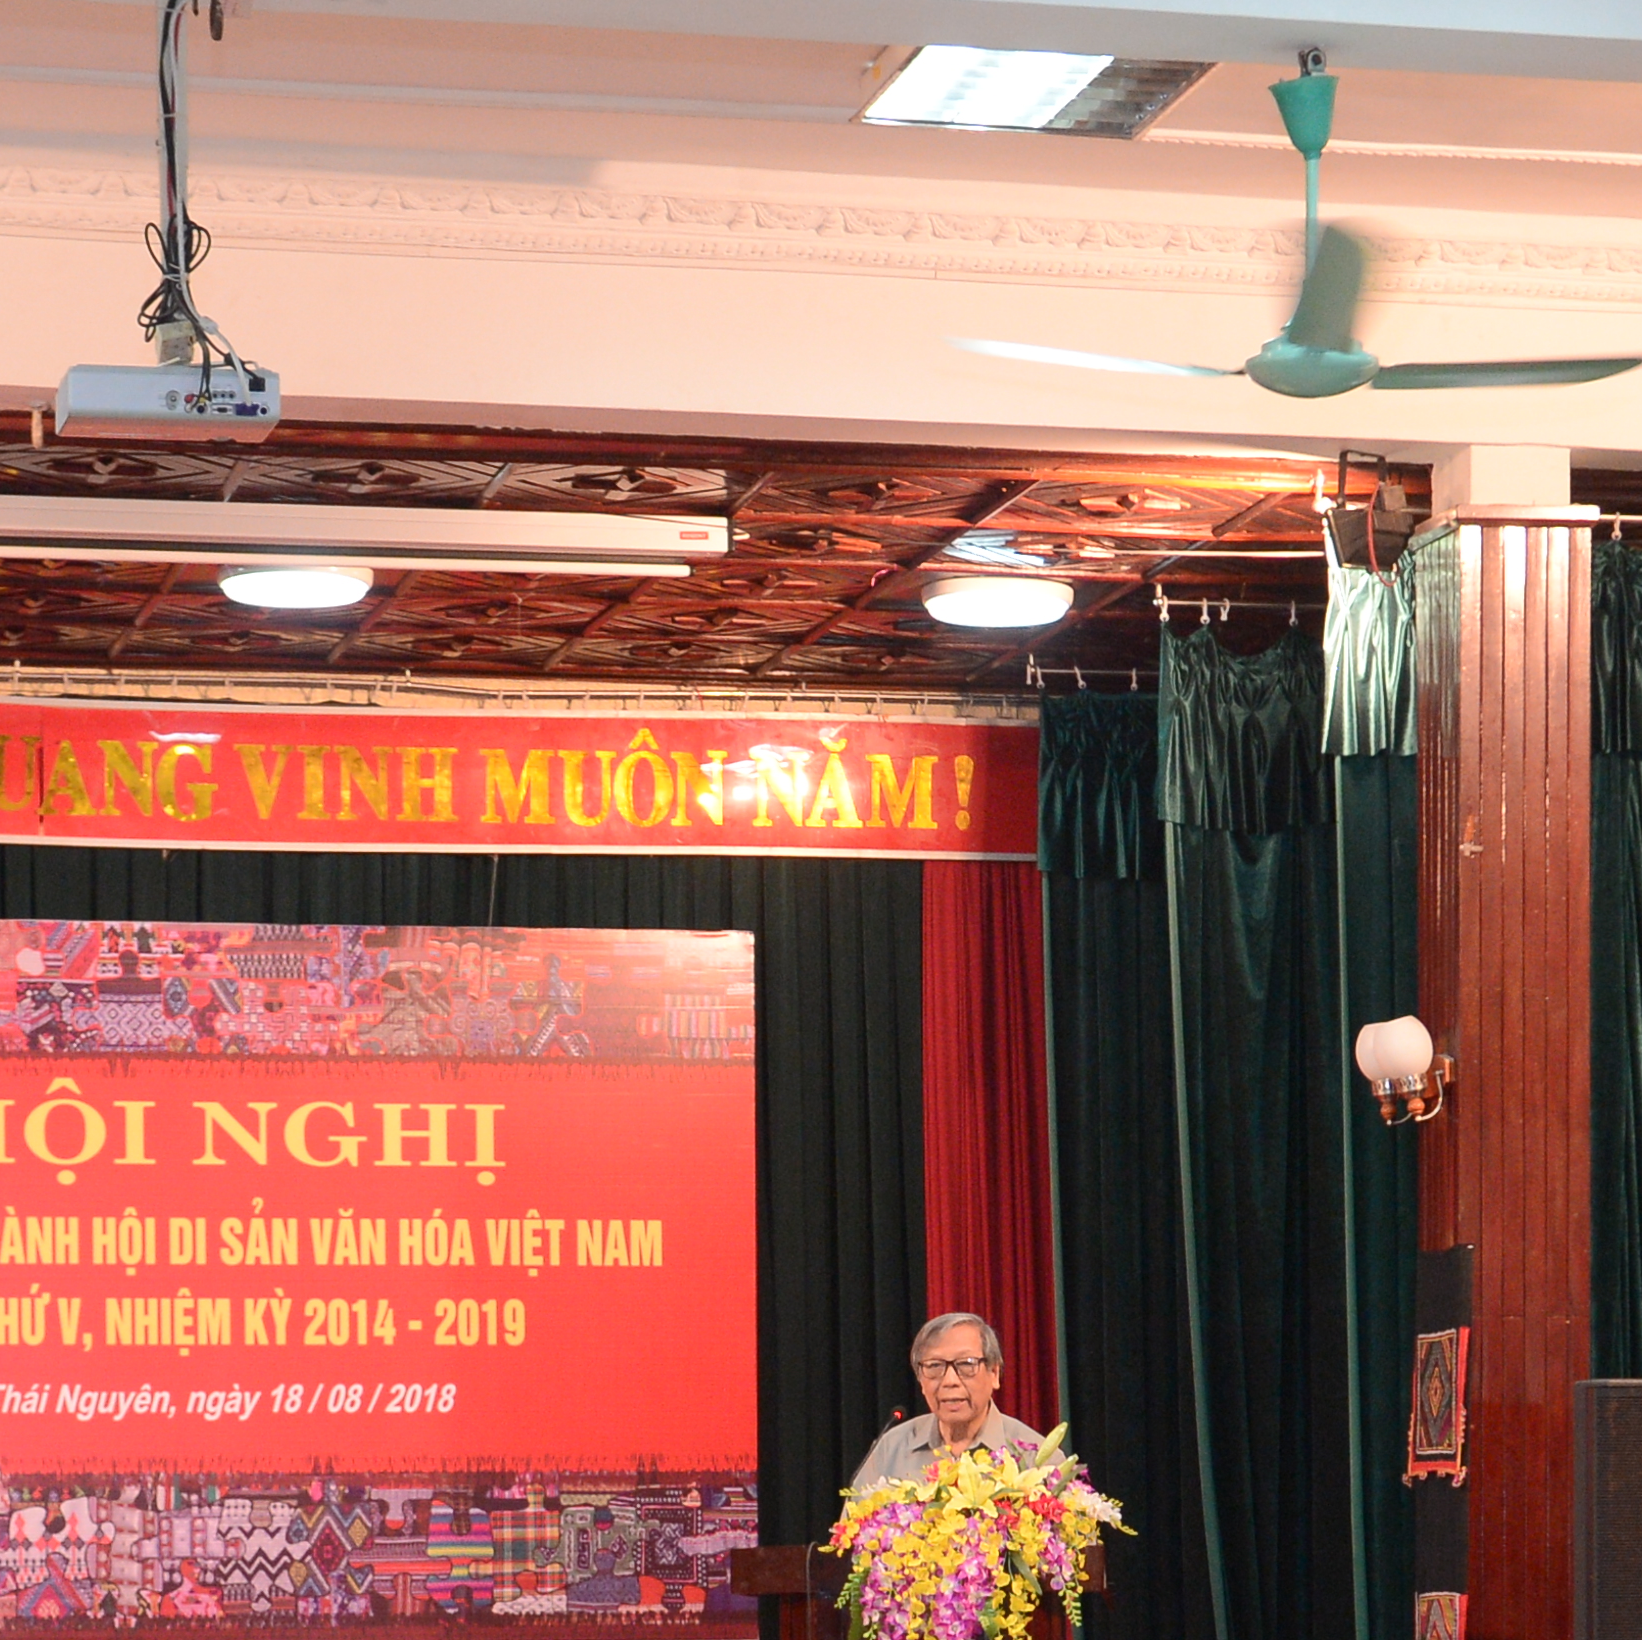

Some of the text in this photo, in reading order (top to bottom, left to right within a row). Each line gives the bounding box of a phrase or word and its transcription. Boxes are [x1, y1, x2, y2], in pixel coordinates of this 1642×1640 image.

[234, 743, 459, 823] VINH
[479, 727, 726, 828] MUÔN
[192, 1101, 506, 1186] NGHỊ
[92, 1206, 156, 1276] HỘI
[169, 1217, 207, 1266] DI
[219, 1197, 298, 1266] SẢN
[309, 1208, 386, 1266] VĂN
[399, 1208, 475, 1267] HÓA
[486, 1208, 565, 1277] VIỆT
[577, 1218, 663, 1267] NAM
[58, 1297, 93, 1352] V,
[105, 1288, 232, 1357] NHIỆM
[244, 1288, 292, 1346] KỲ
[303, 1298, 396, 1346] 2014
[434, 1298, 526, 1346] 2019
[55, 1384, 177, 1421] Nguyên,
[186, 1384, 262, 1421] ngày
